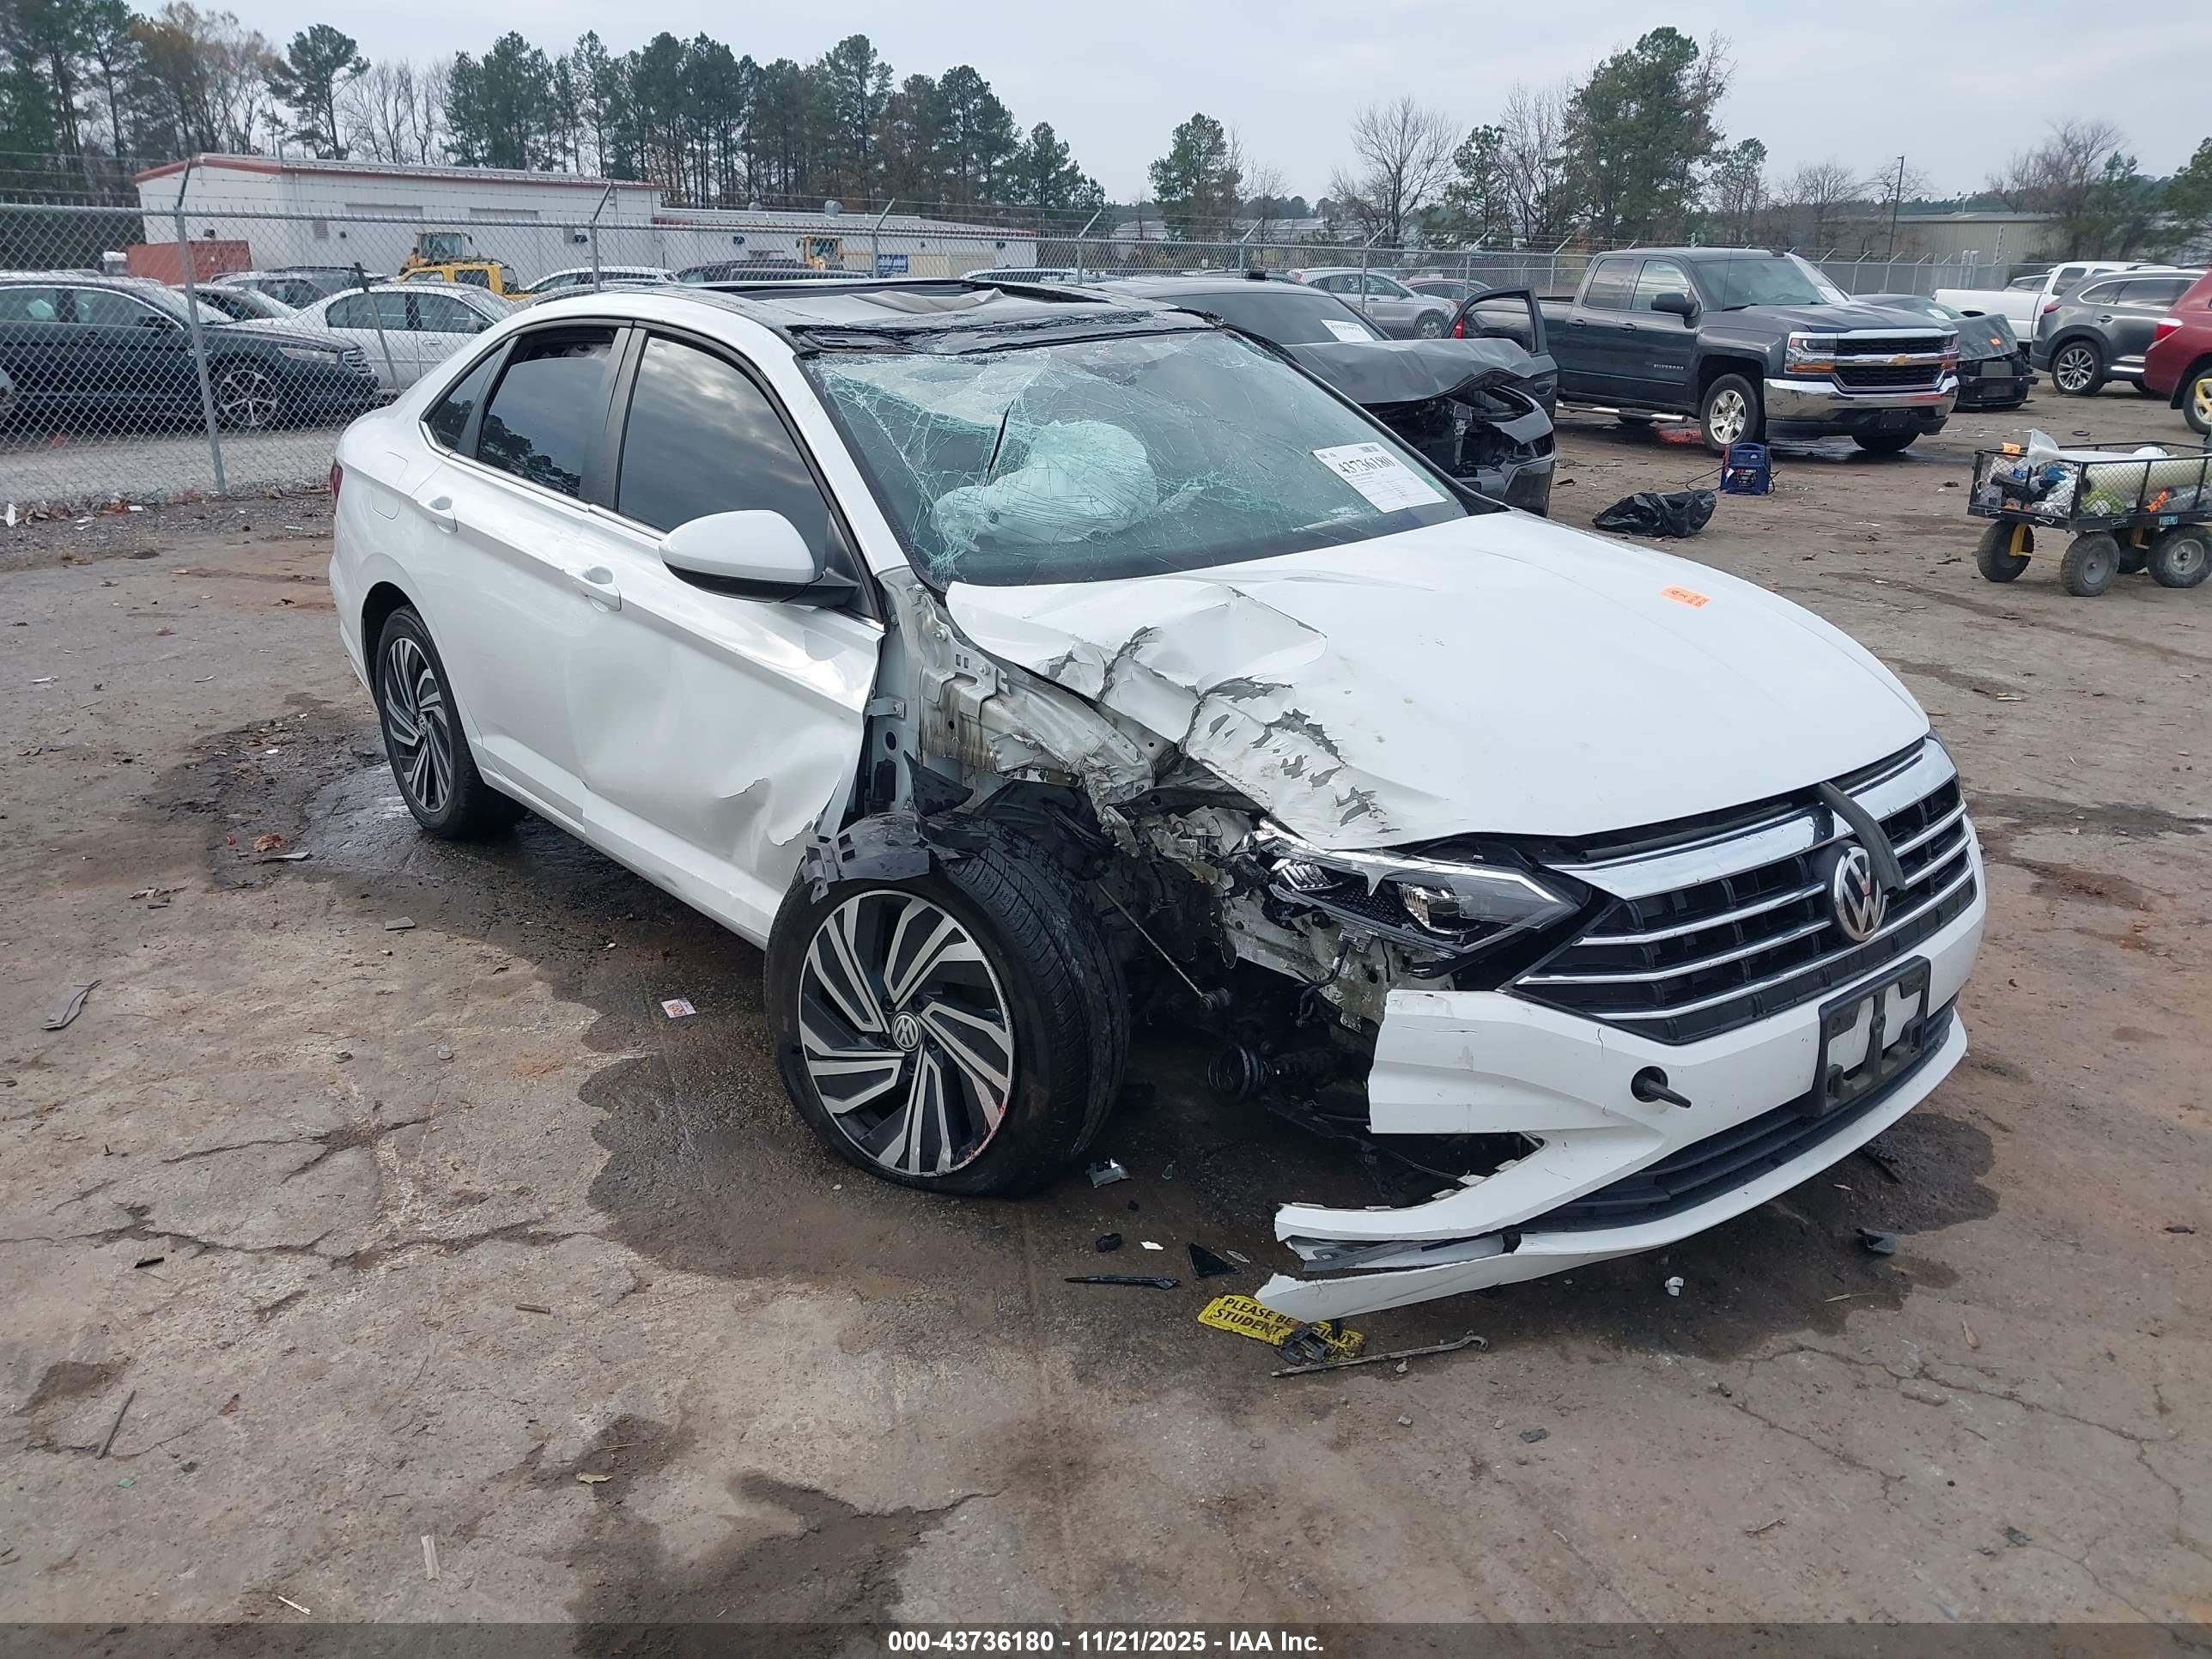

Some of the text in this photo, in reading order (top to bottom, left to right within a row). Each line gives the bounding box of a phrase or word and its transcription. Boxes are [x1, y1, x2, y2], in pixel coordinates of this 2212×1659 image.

[1338, 455, 1396, 474] 43736180
[1213, 1308, 1284, 1336] STUDENT
[1223, 1297, 1295, 1326] PLEASE BE
